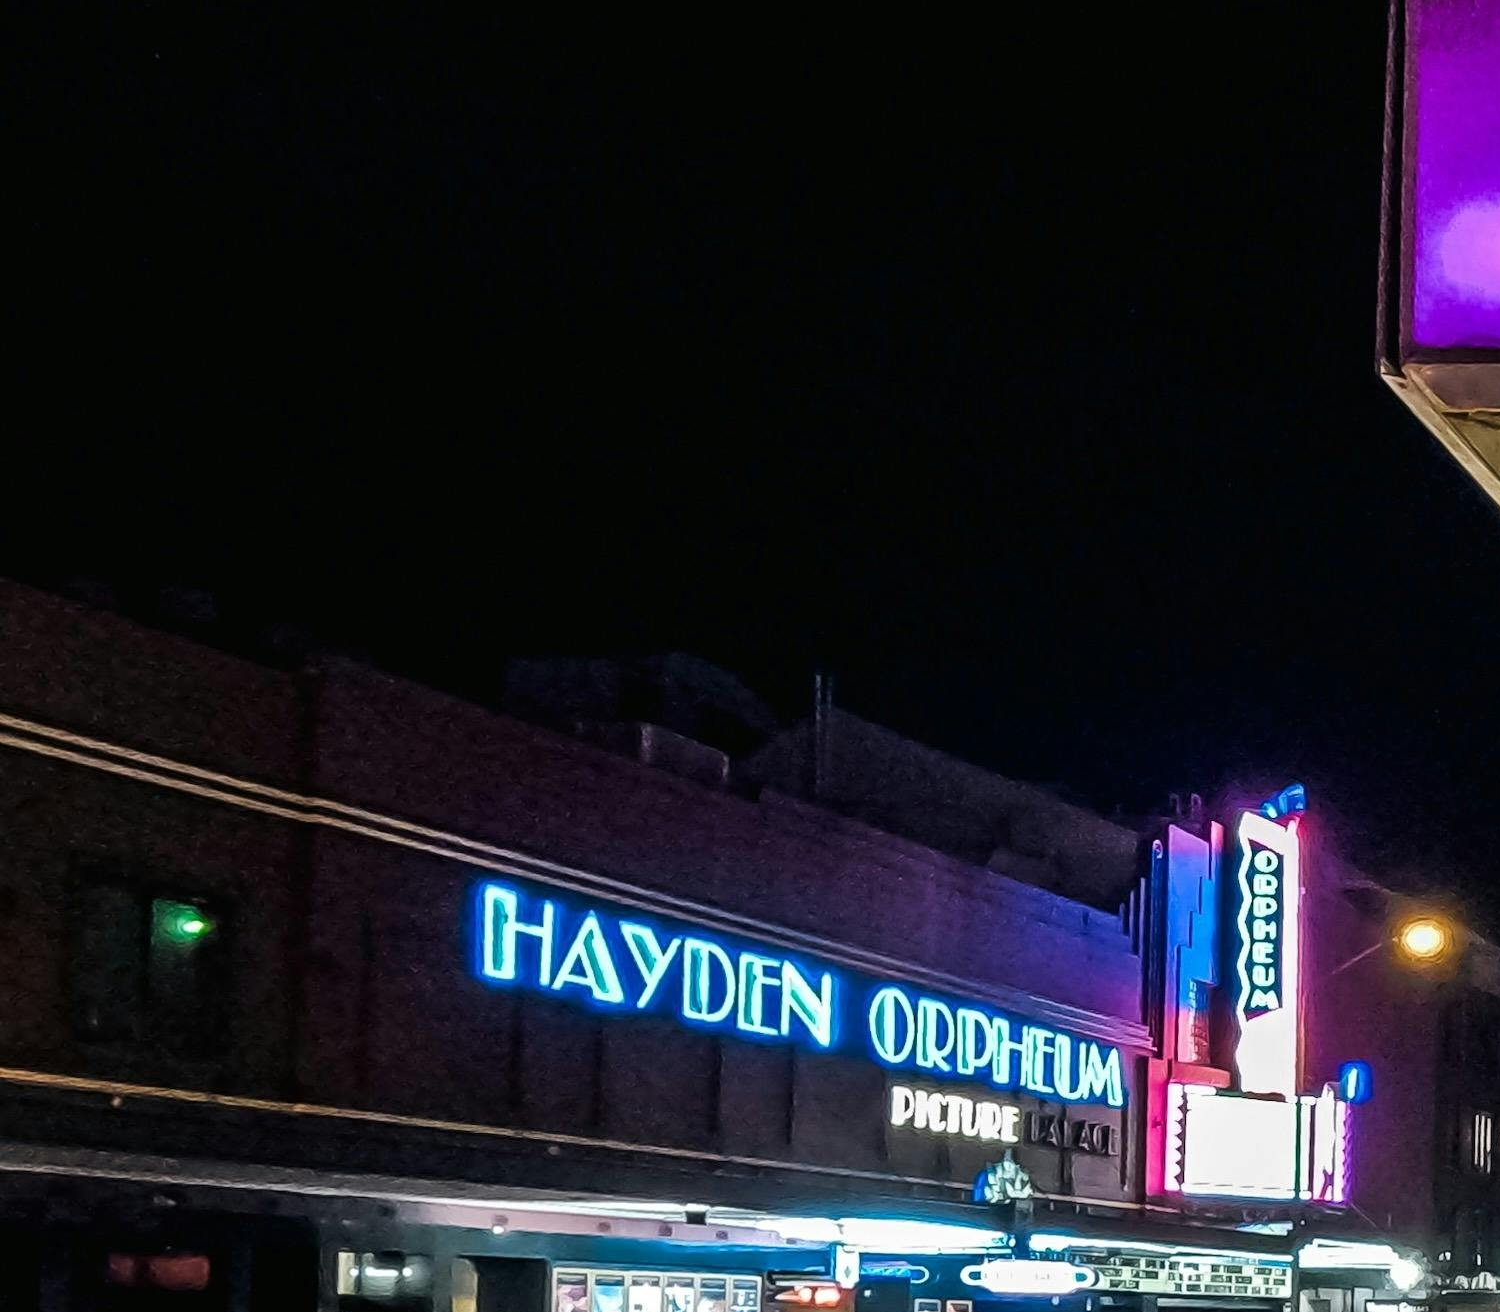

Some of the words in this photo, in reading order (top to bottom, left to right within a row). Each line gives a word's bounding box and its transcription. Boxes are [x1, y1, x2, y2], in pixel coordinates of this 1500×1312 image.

[483, 884, 832, 1048] HAYDEN
[869, 987, 1124, 1107] ORPHEUM
[1251, 849, 1280, 1010] ORPHEUM
[891, 1086, 1020, 1144] PICTURE
